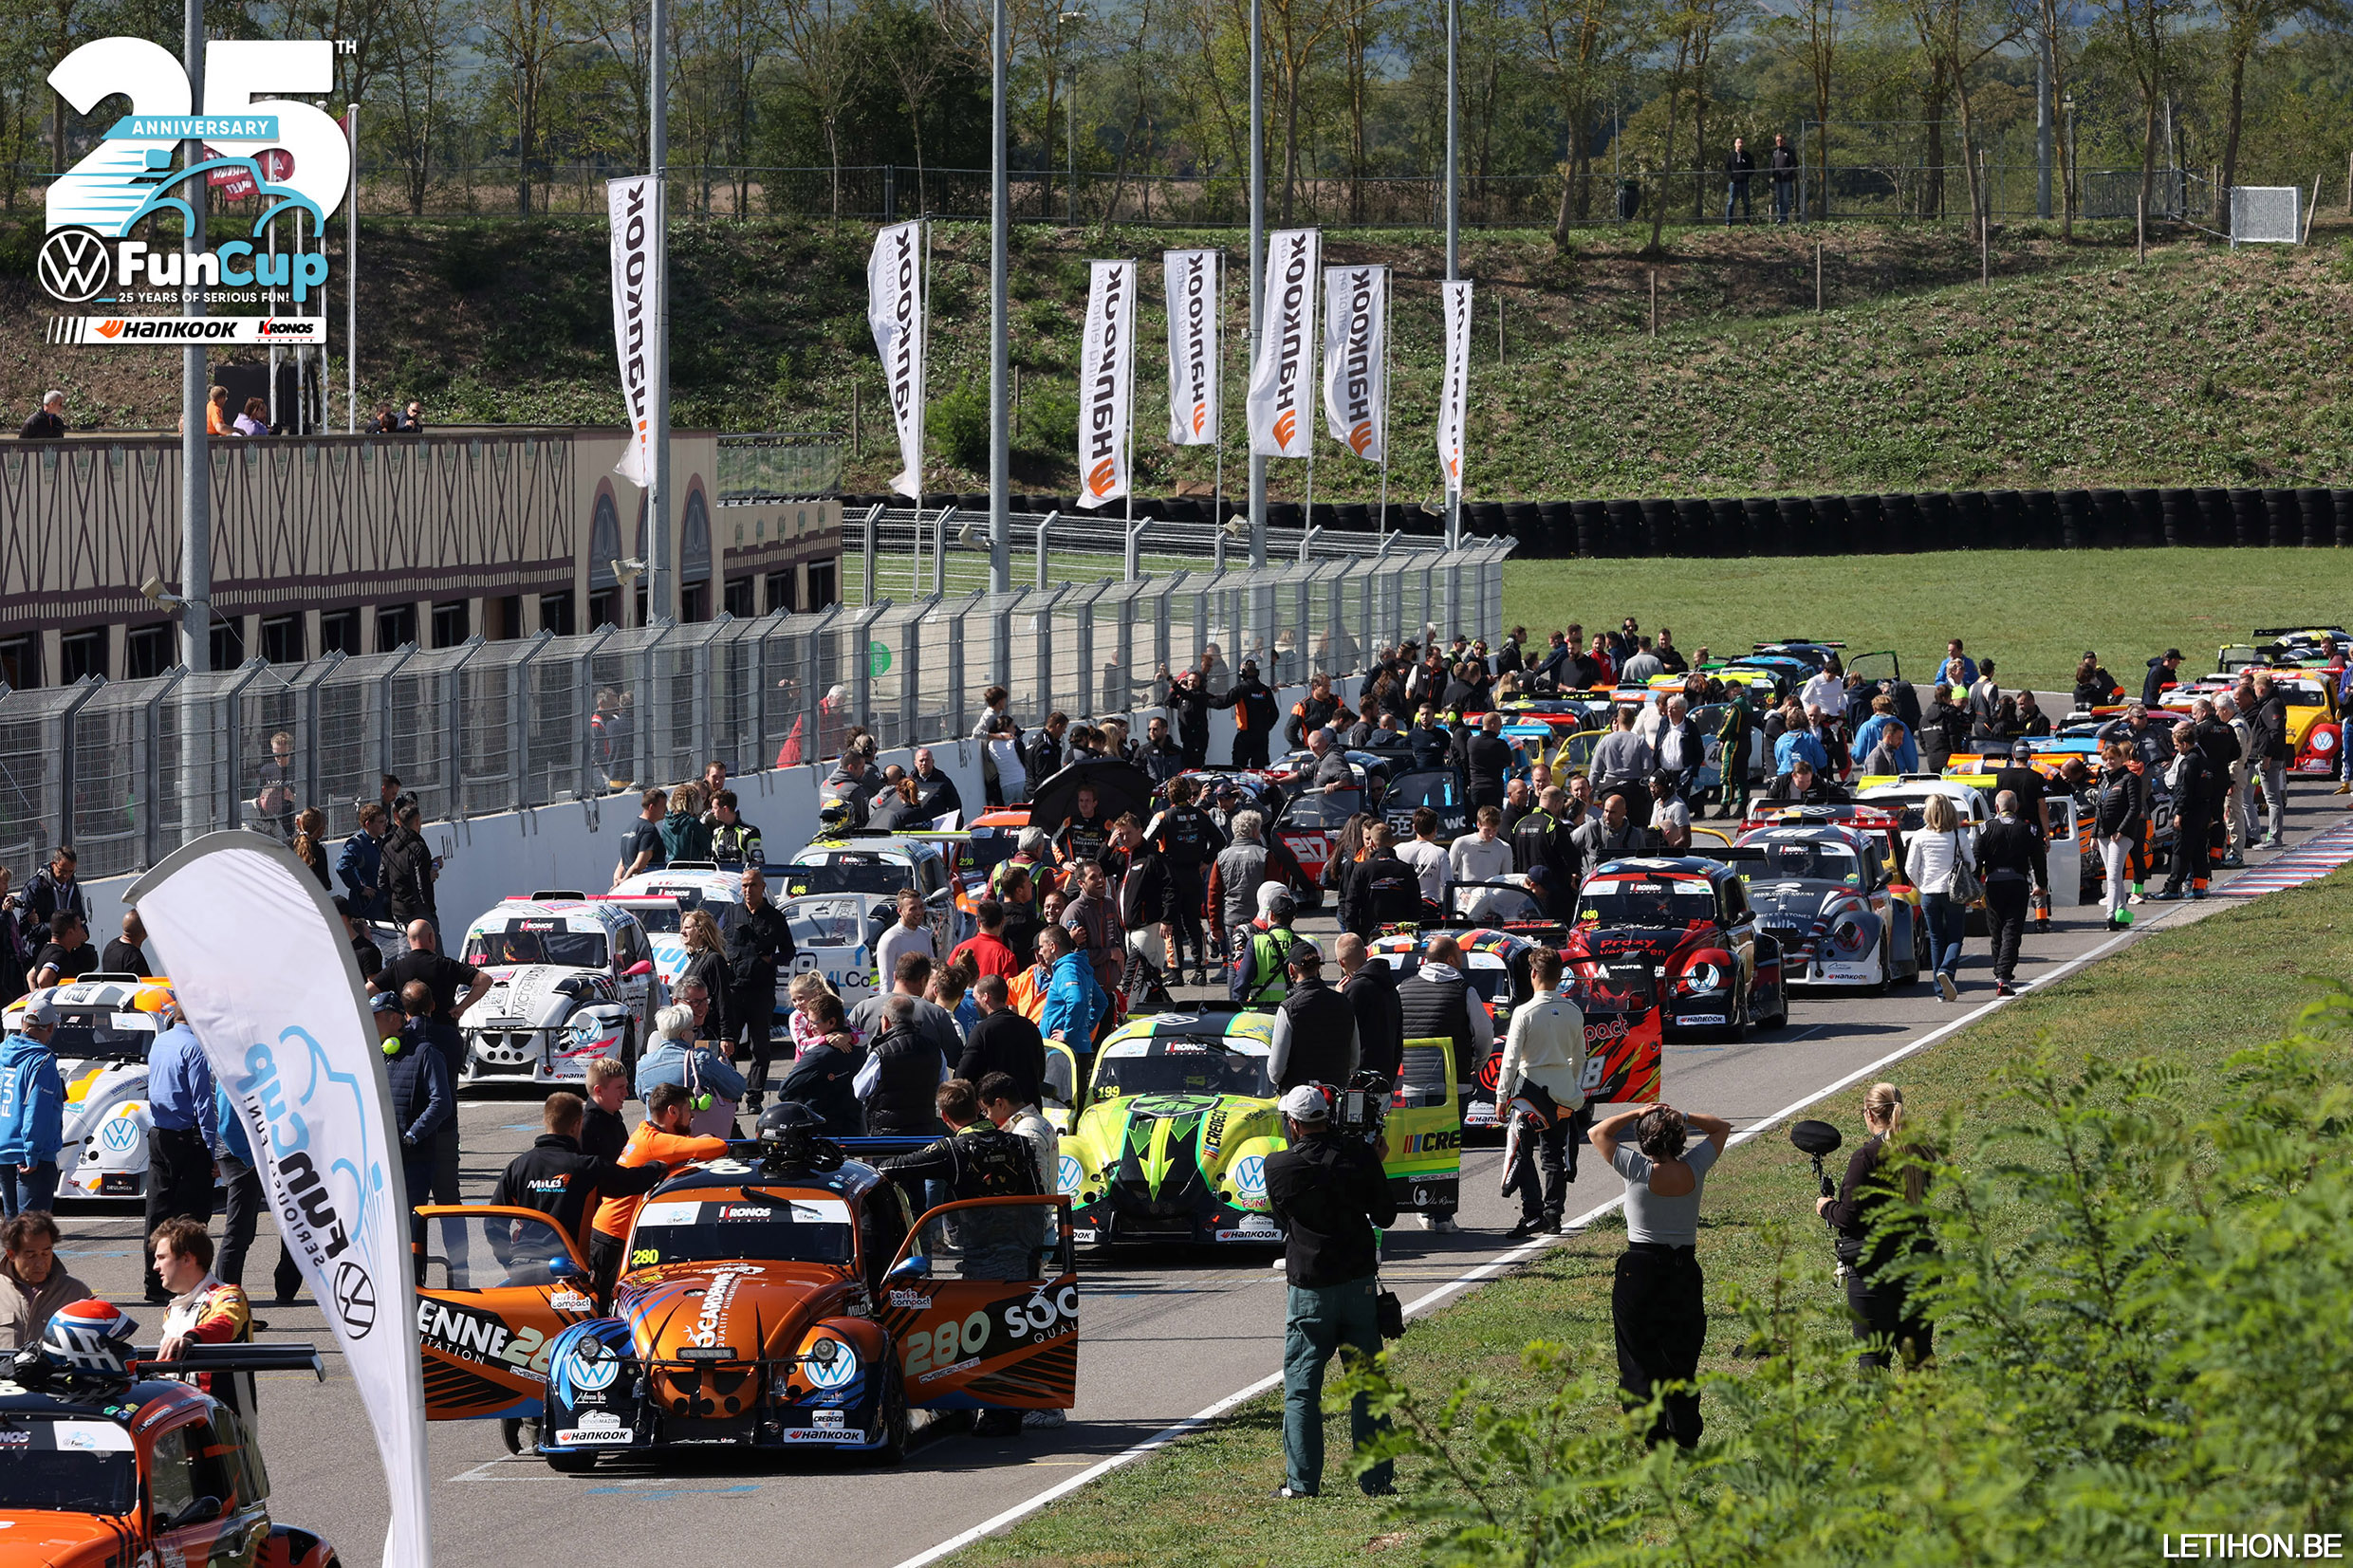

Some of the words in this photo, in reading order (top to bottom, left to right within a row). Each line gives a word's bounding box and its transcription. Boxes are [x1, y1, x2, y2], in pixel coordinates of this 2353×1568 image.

[1581, 910, 1599, 919] 480
[520, 919, 554, 931] KRONOS
[1600, 938, 1658, 950] Proxy
[1097, 1086, 1121, 1098] 199
[718, 1204, 771, 1218] KRONOS
[631, 1249, 659, 1264] 280
[892, 1297, 932, 1308] compact
[905, 1310, 991, 1377] 280
